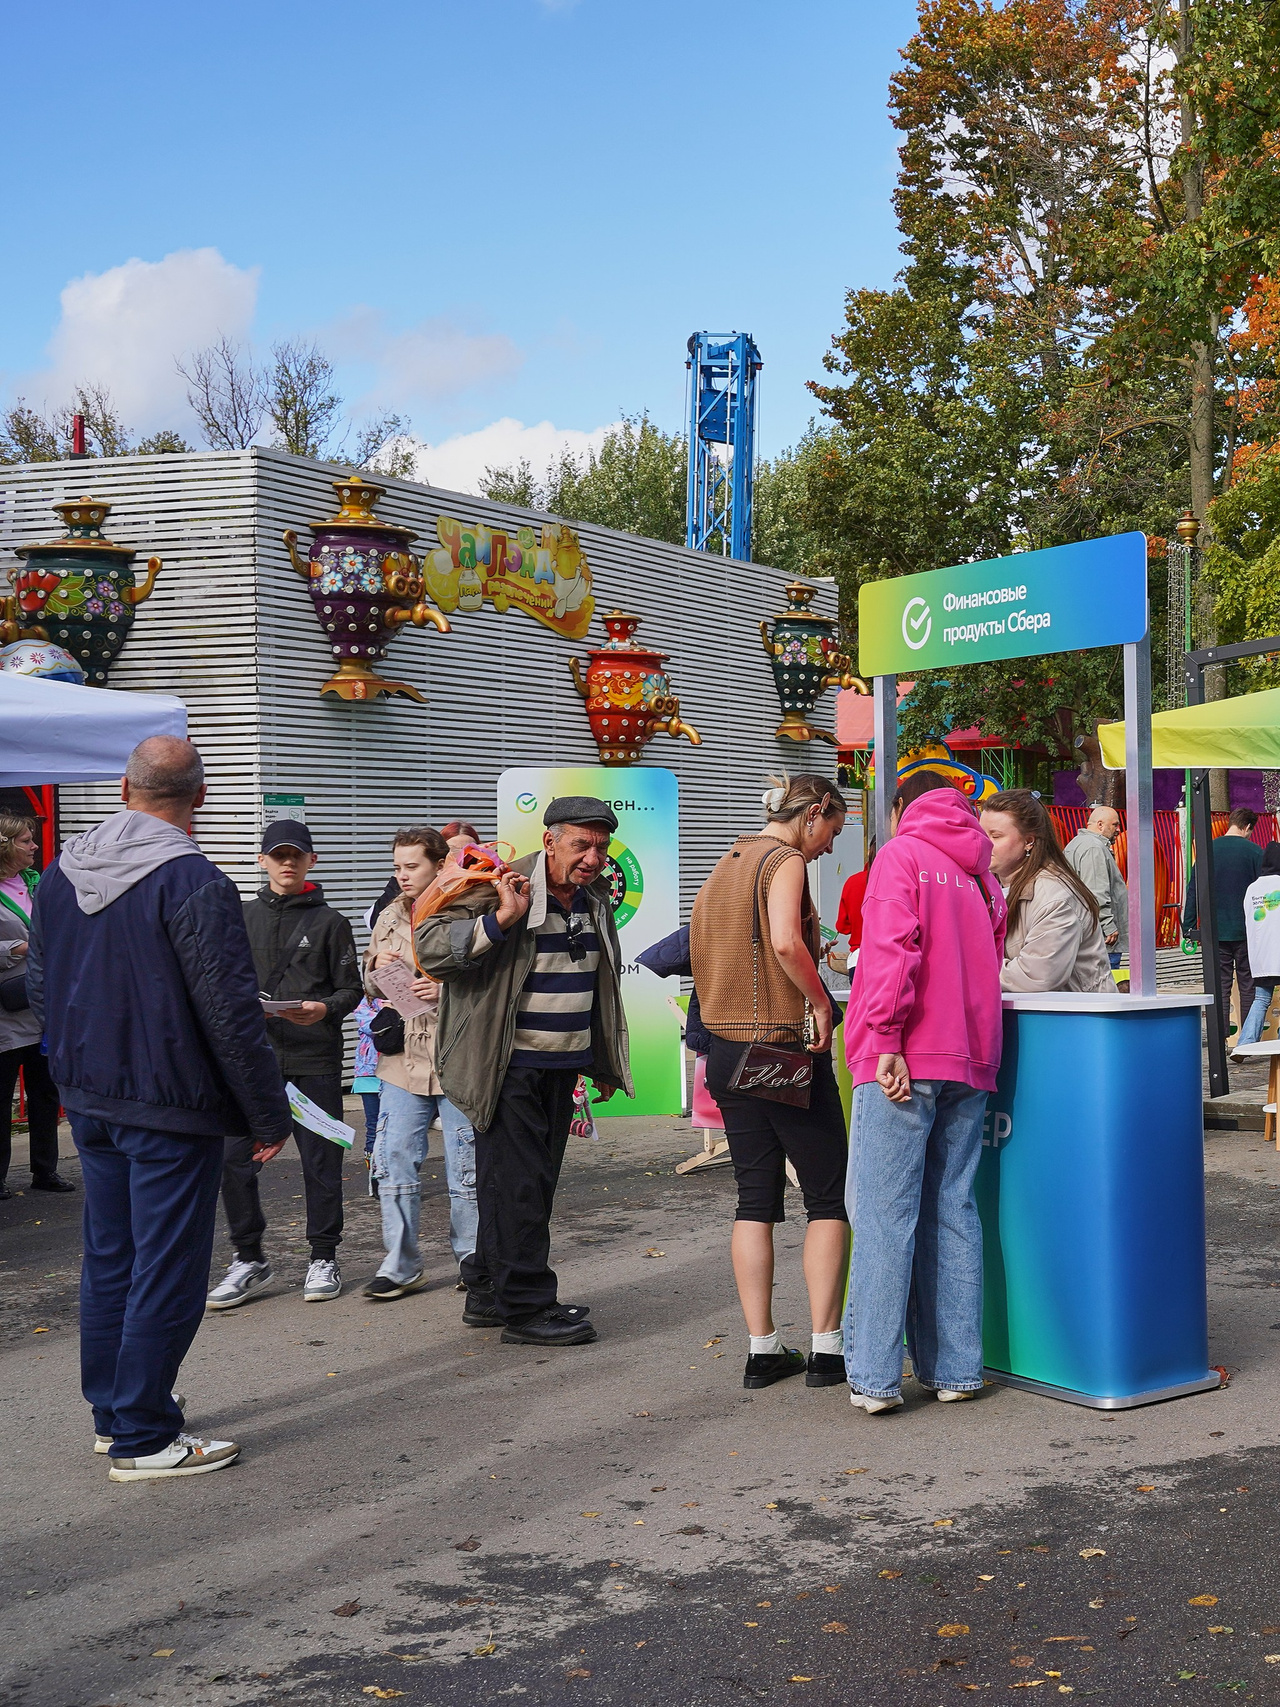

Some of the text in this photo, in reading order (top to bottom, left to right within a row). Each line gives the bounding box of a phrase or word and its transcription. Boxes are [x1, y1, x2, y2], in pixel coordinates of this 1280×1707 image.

[943, 584, 1027, 612] Финансовые
[943, 609, 1051, 646] продукты Сбера
[919, 870, 1003, 919] CULTRE
[740, 1063, 811, 1090] Karl
